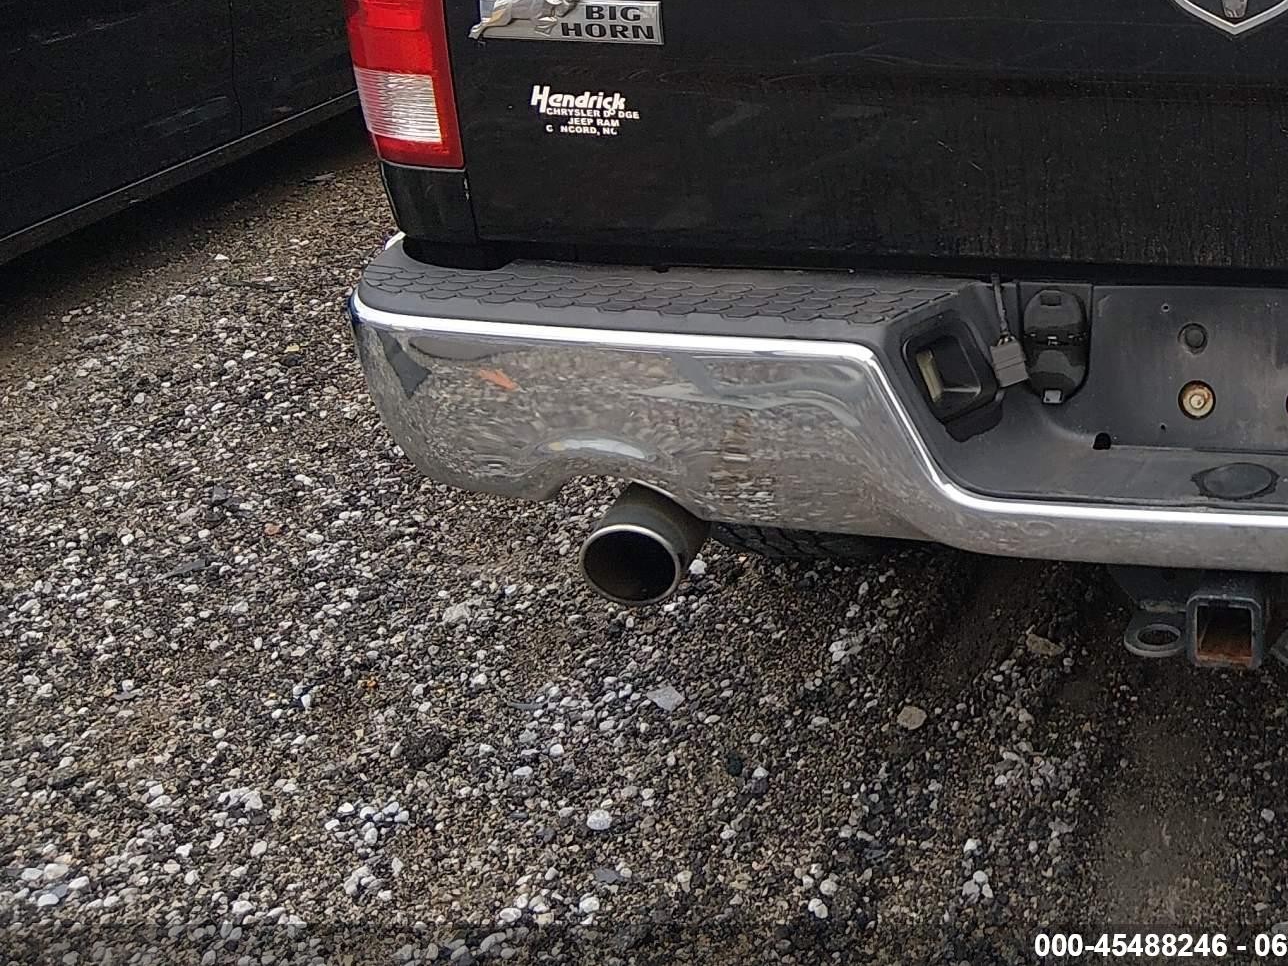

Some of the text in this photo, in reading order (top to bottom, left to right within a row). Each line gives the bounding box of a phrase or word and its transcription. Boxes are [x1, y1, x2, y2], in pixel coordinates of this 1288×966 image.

[584, 4, 642, 23] BIG
[560, 22, 656, 40] HORN
[530, 85, 627, 113] Hendrick
[545, 107, 602, 118] CHRYSLER
[567, 117, 620, 127] JEEP RAM
[545, 124, 601, 136] CNCORD,
